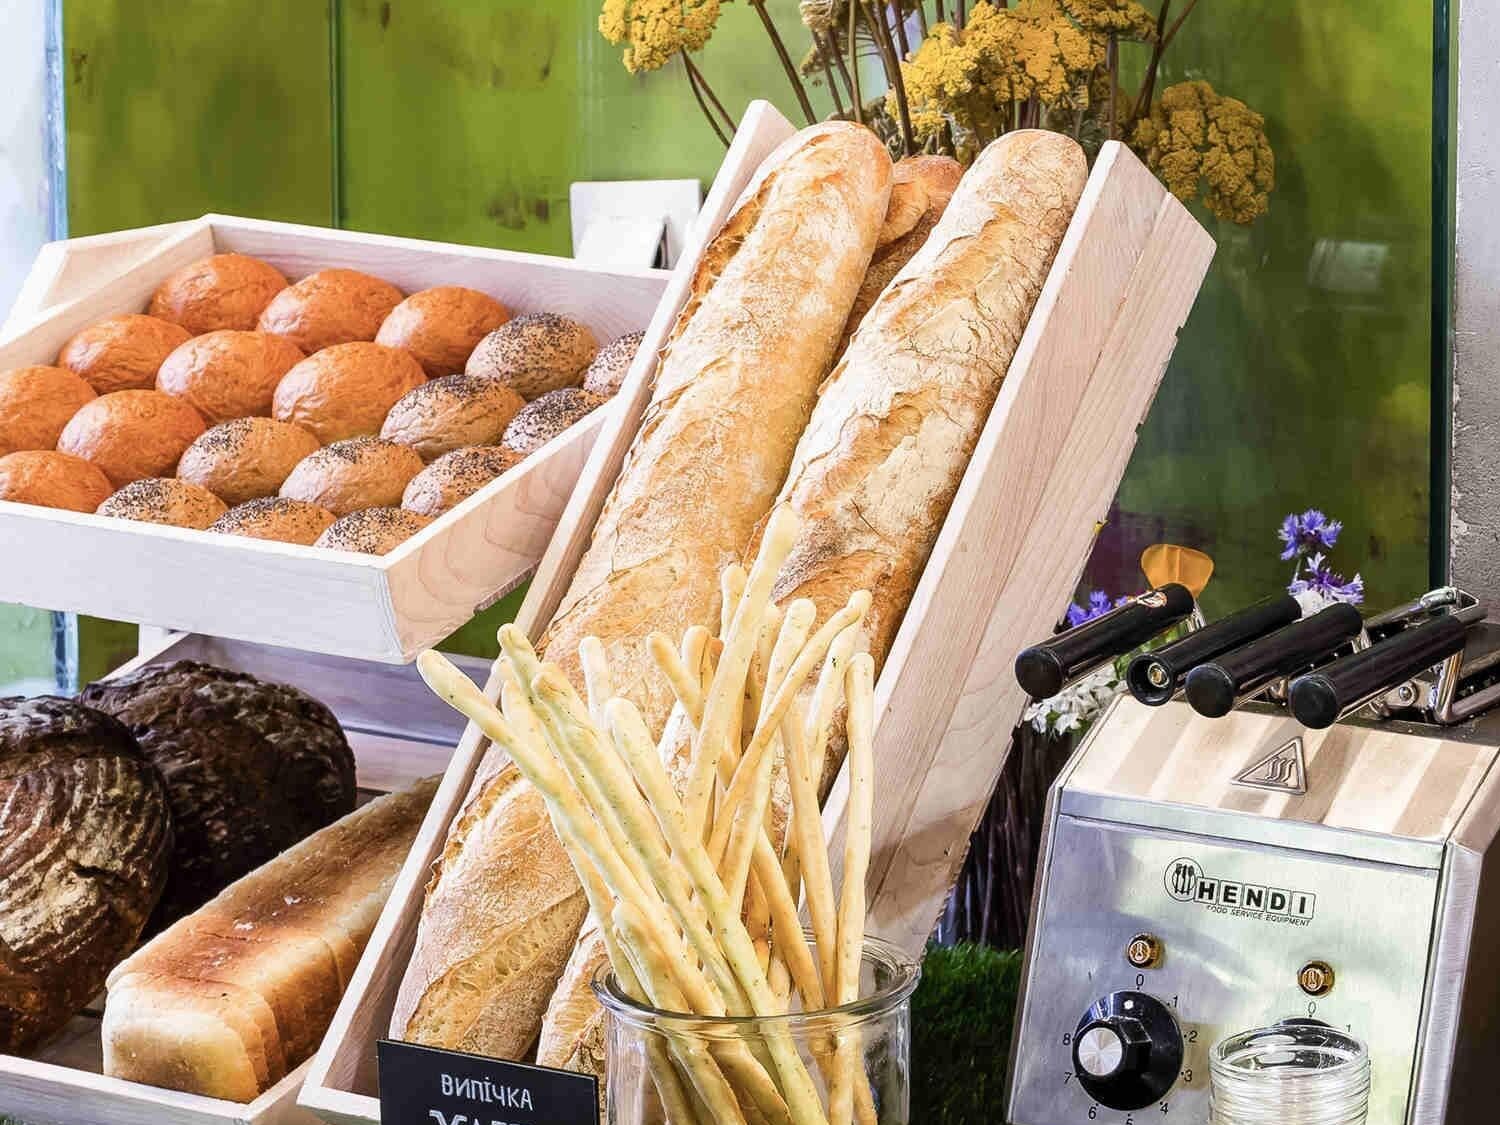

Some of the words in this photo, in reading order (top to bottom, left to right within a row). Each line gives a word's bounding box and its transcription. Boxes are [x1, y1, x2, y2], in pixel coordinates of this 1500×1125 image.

[1198, 883, 1306, 914] HENDI
[1230, 908, 1263, 920] SERVICE
[1264, 915, 1311, 927] EQUIPMENT
[1136, 973, 1144, 986] 0
[1173, 995, 1178, 1008] 1
[1307, 1001, 1317, 1015] 0
[1062, 1033, 1071, 1046] 8
[1188, 1030, 1198, 1043] 2
[1064, 1072, 1073, 1084] 7
[1183, 1069, 1193, 1082] 3
[441, 1073, 533, 1111] ВИПІЧКА
[1088, 1106, 1097, 1120] 6
[1160, 1102, 1168, 1114] 4
